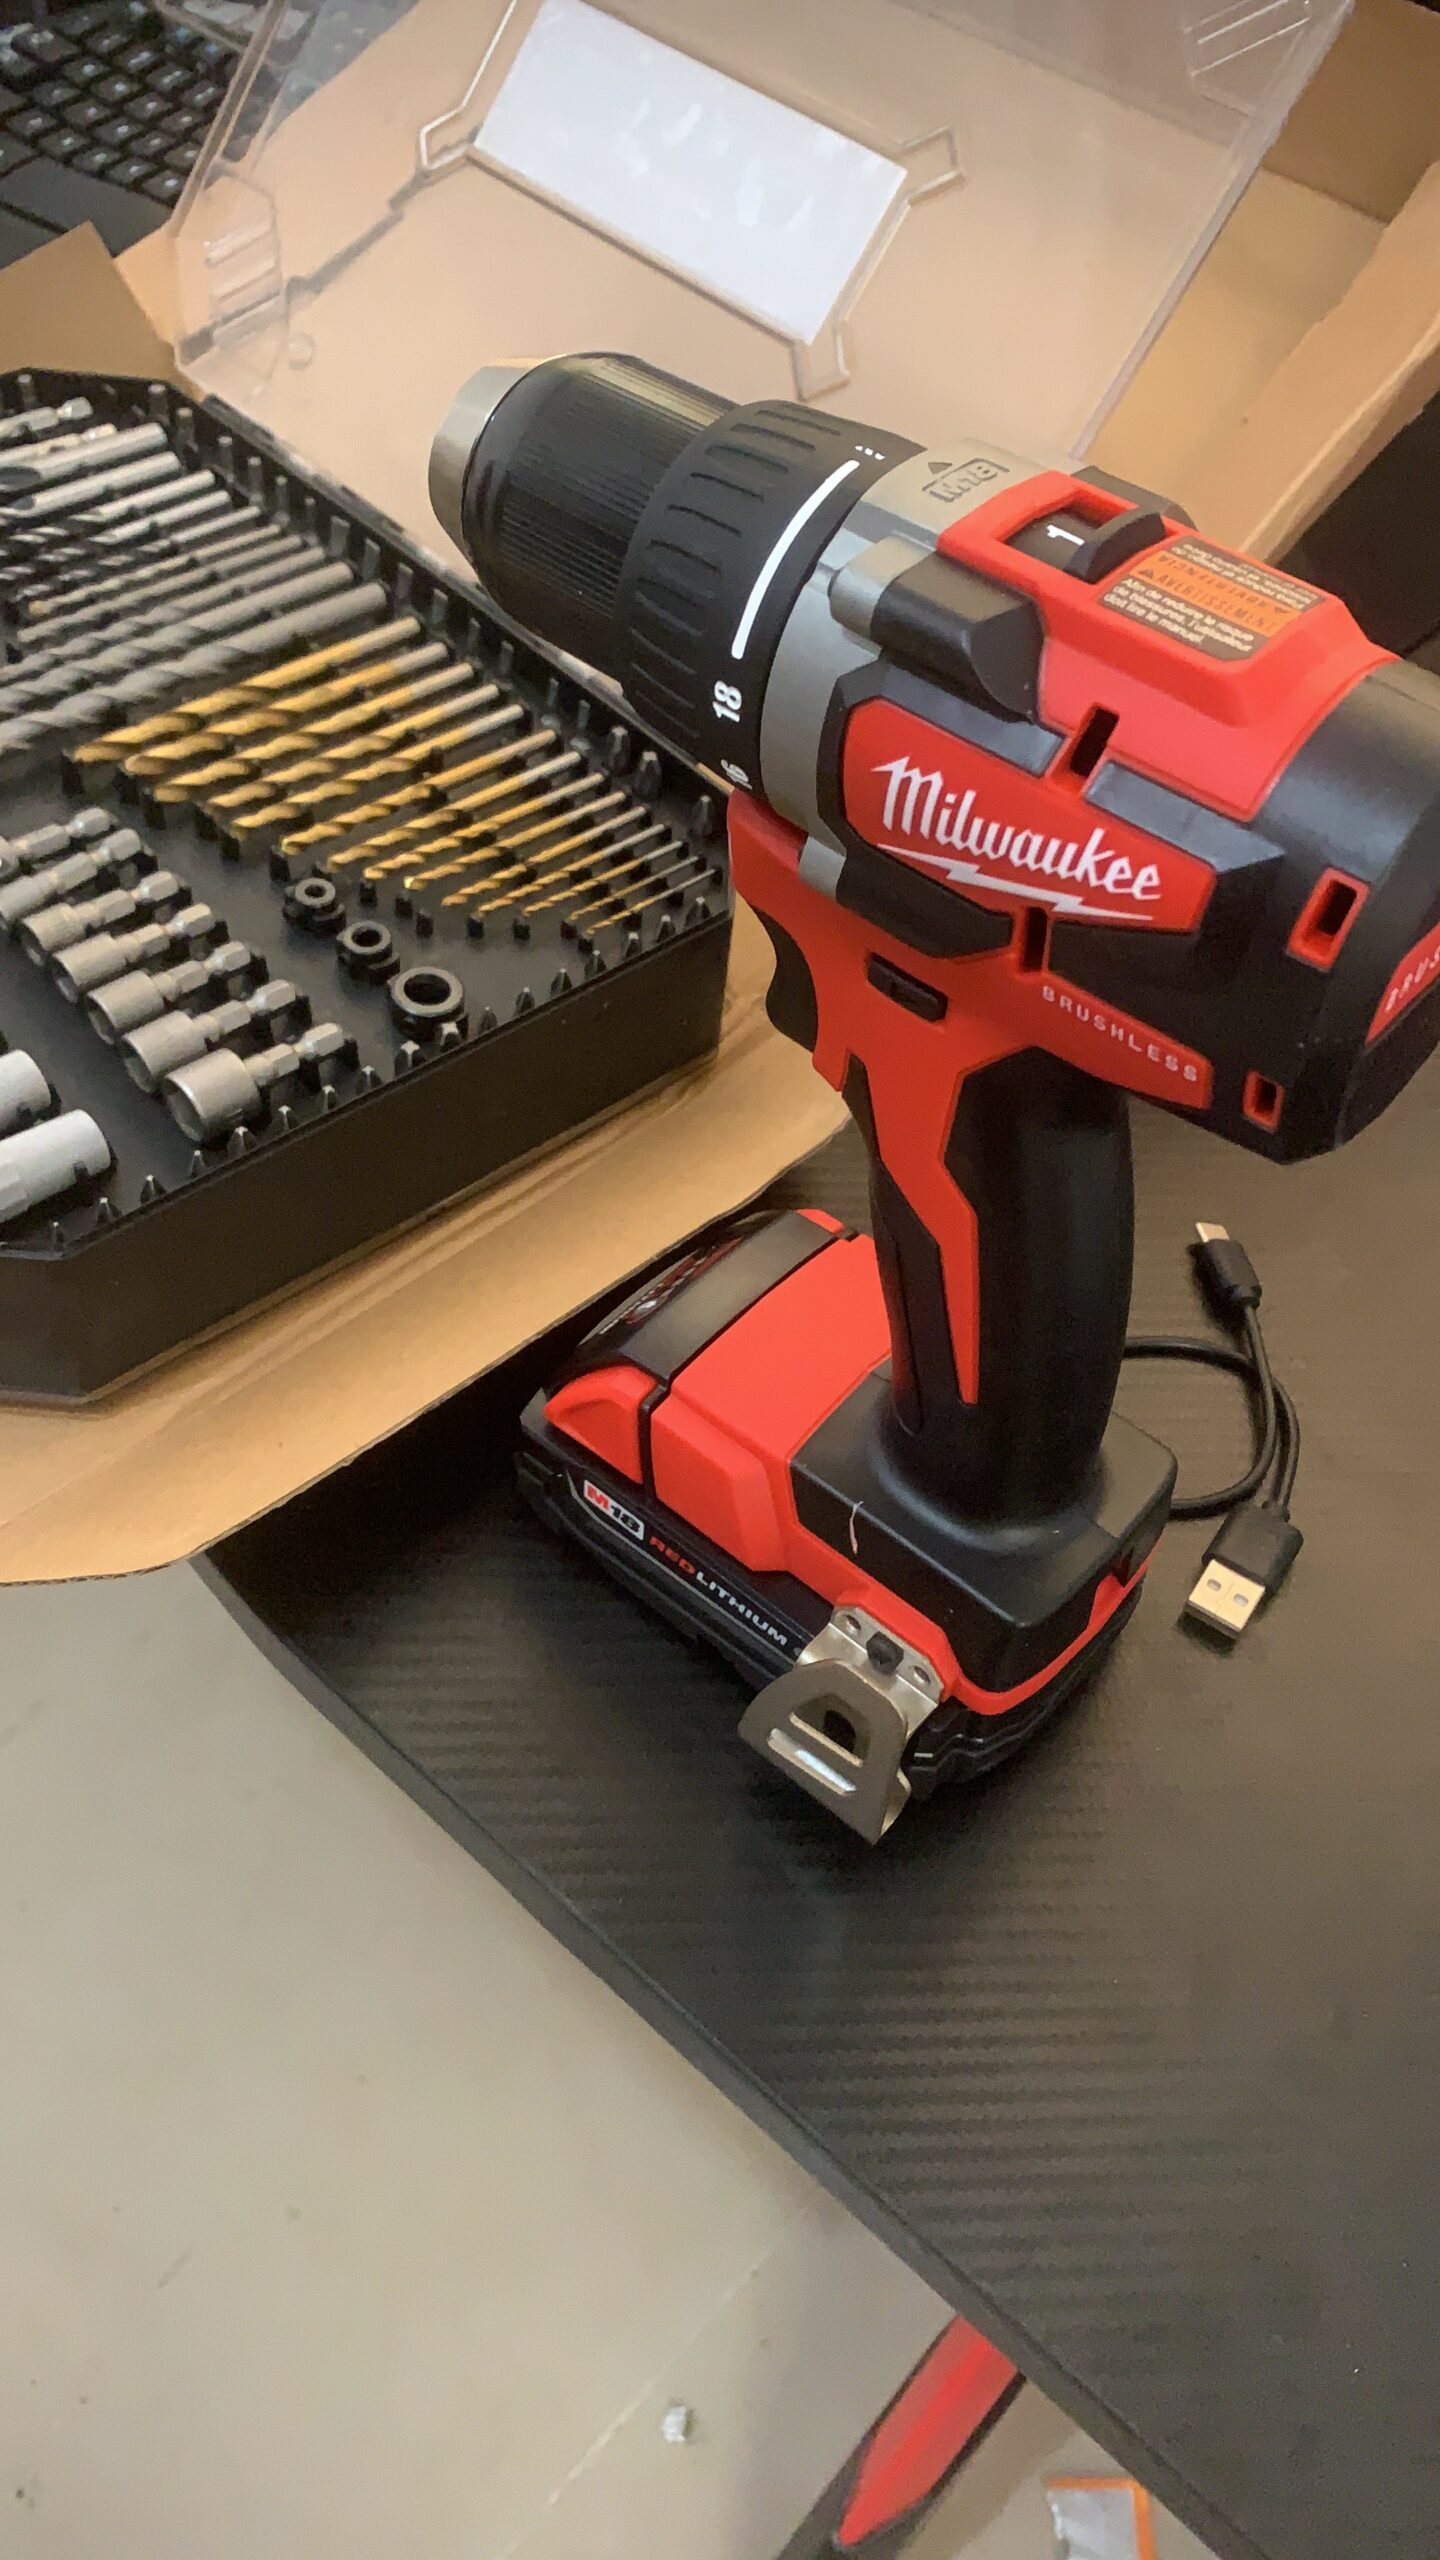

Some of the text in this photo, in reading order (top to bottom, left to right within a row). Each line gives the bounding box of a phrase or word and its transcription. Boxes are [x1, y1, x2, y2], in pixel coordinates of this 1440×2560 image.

[1046, 525, 1085, 546] 1
[712, 680, 742, 722] 18
[871, 756, 1161, 900] Milwaukee
[1043, 986, 1197, 1082] BRUSHLESS
[586, 1483, 641, 1533] M18
